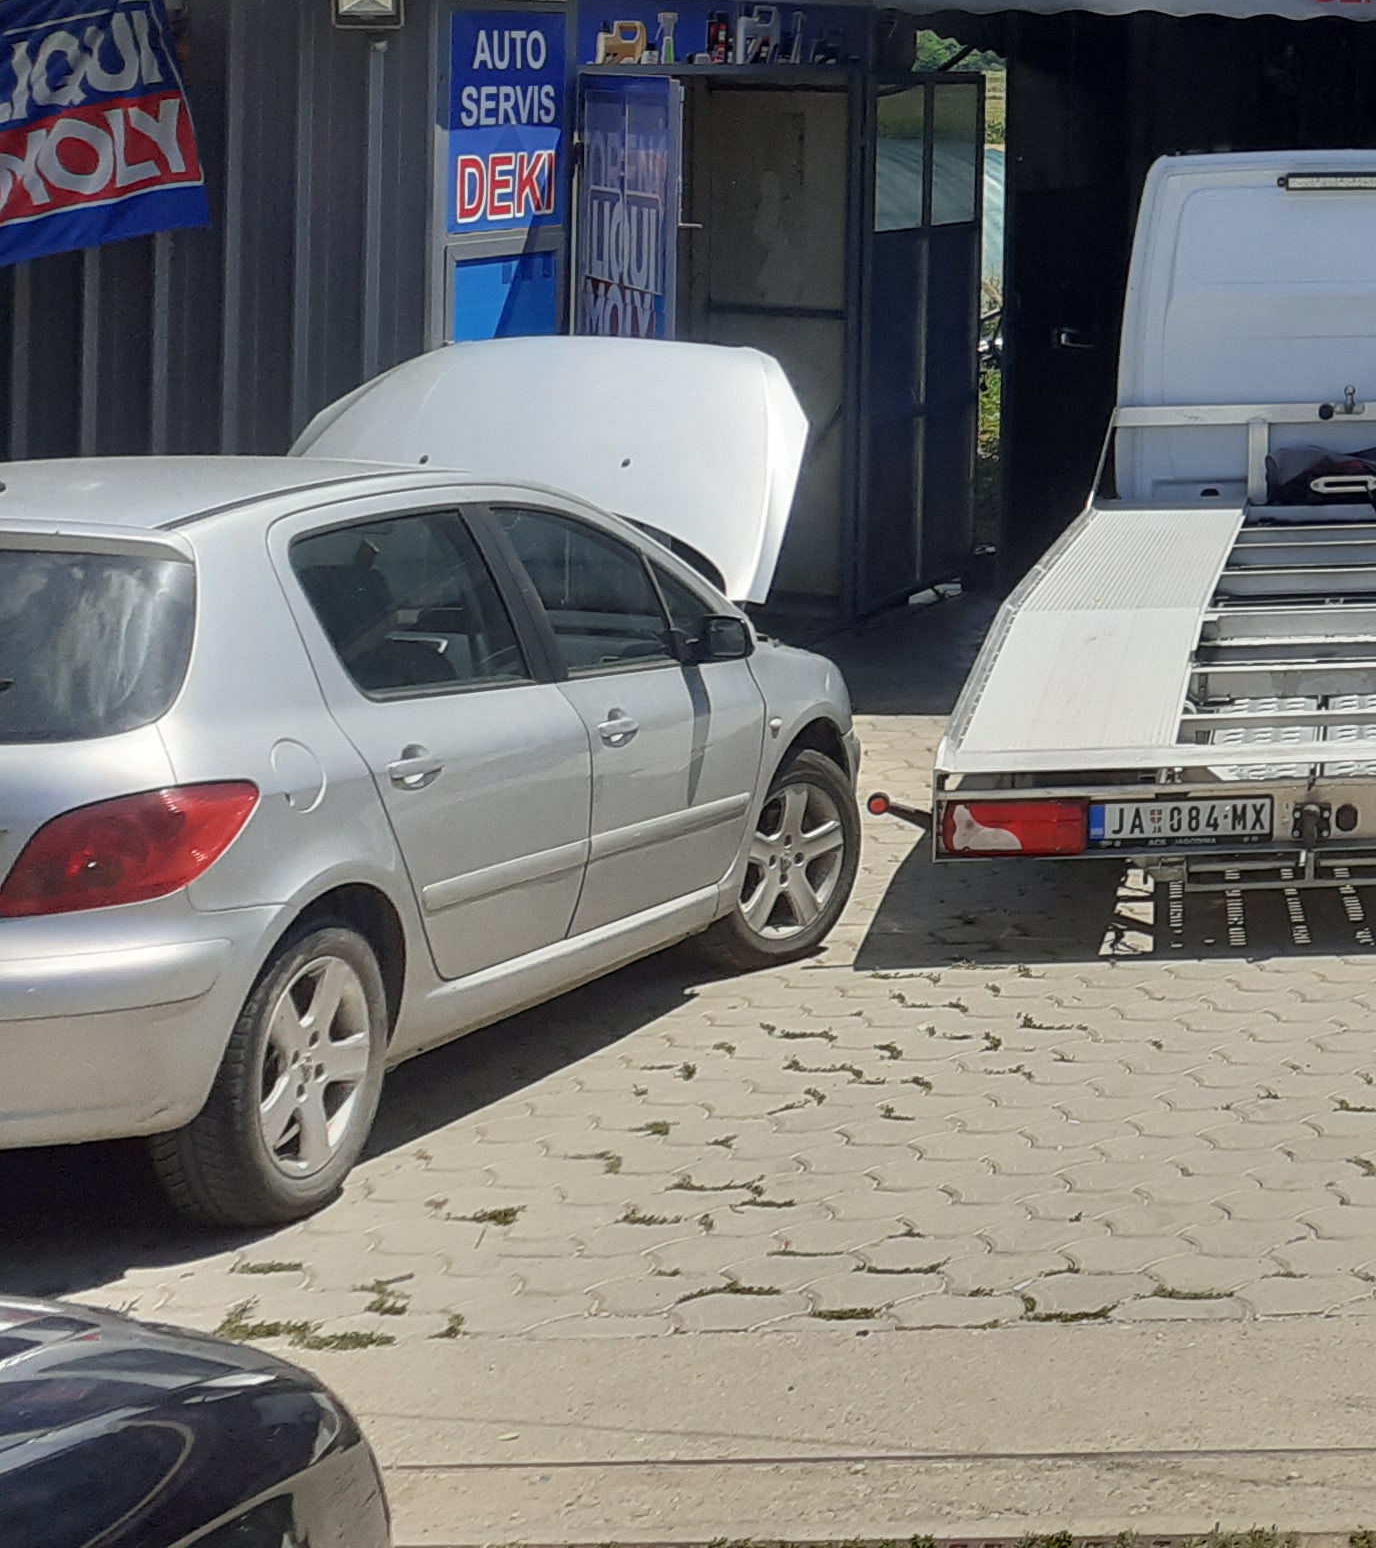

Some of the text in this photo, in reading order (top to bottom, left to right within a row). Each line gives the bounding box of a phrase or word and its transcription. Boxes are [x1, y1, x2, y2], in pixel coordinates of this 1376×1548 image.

[0, 9, 164, 121] IQUI
[473, 29, 546, 71] AUTO
[461, 84, 556, 127] SERVIS
[455, 151, 555, 223] DEKI
[1111, 807, 1145, 835] JA
